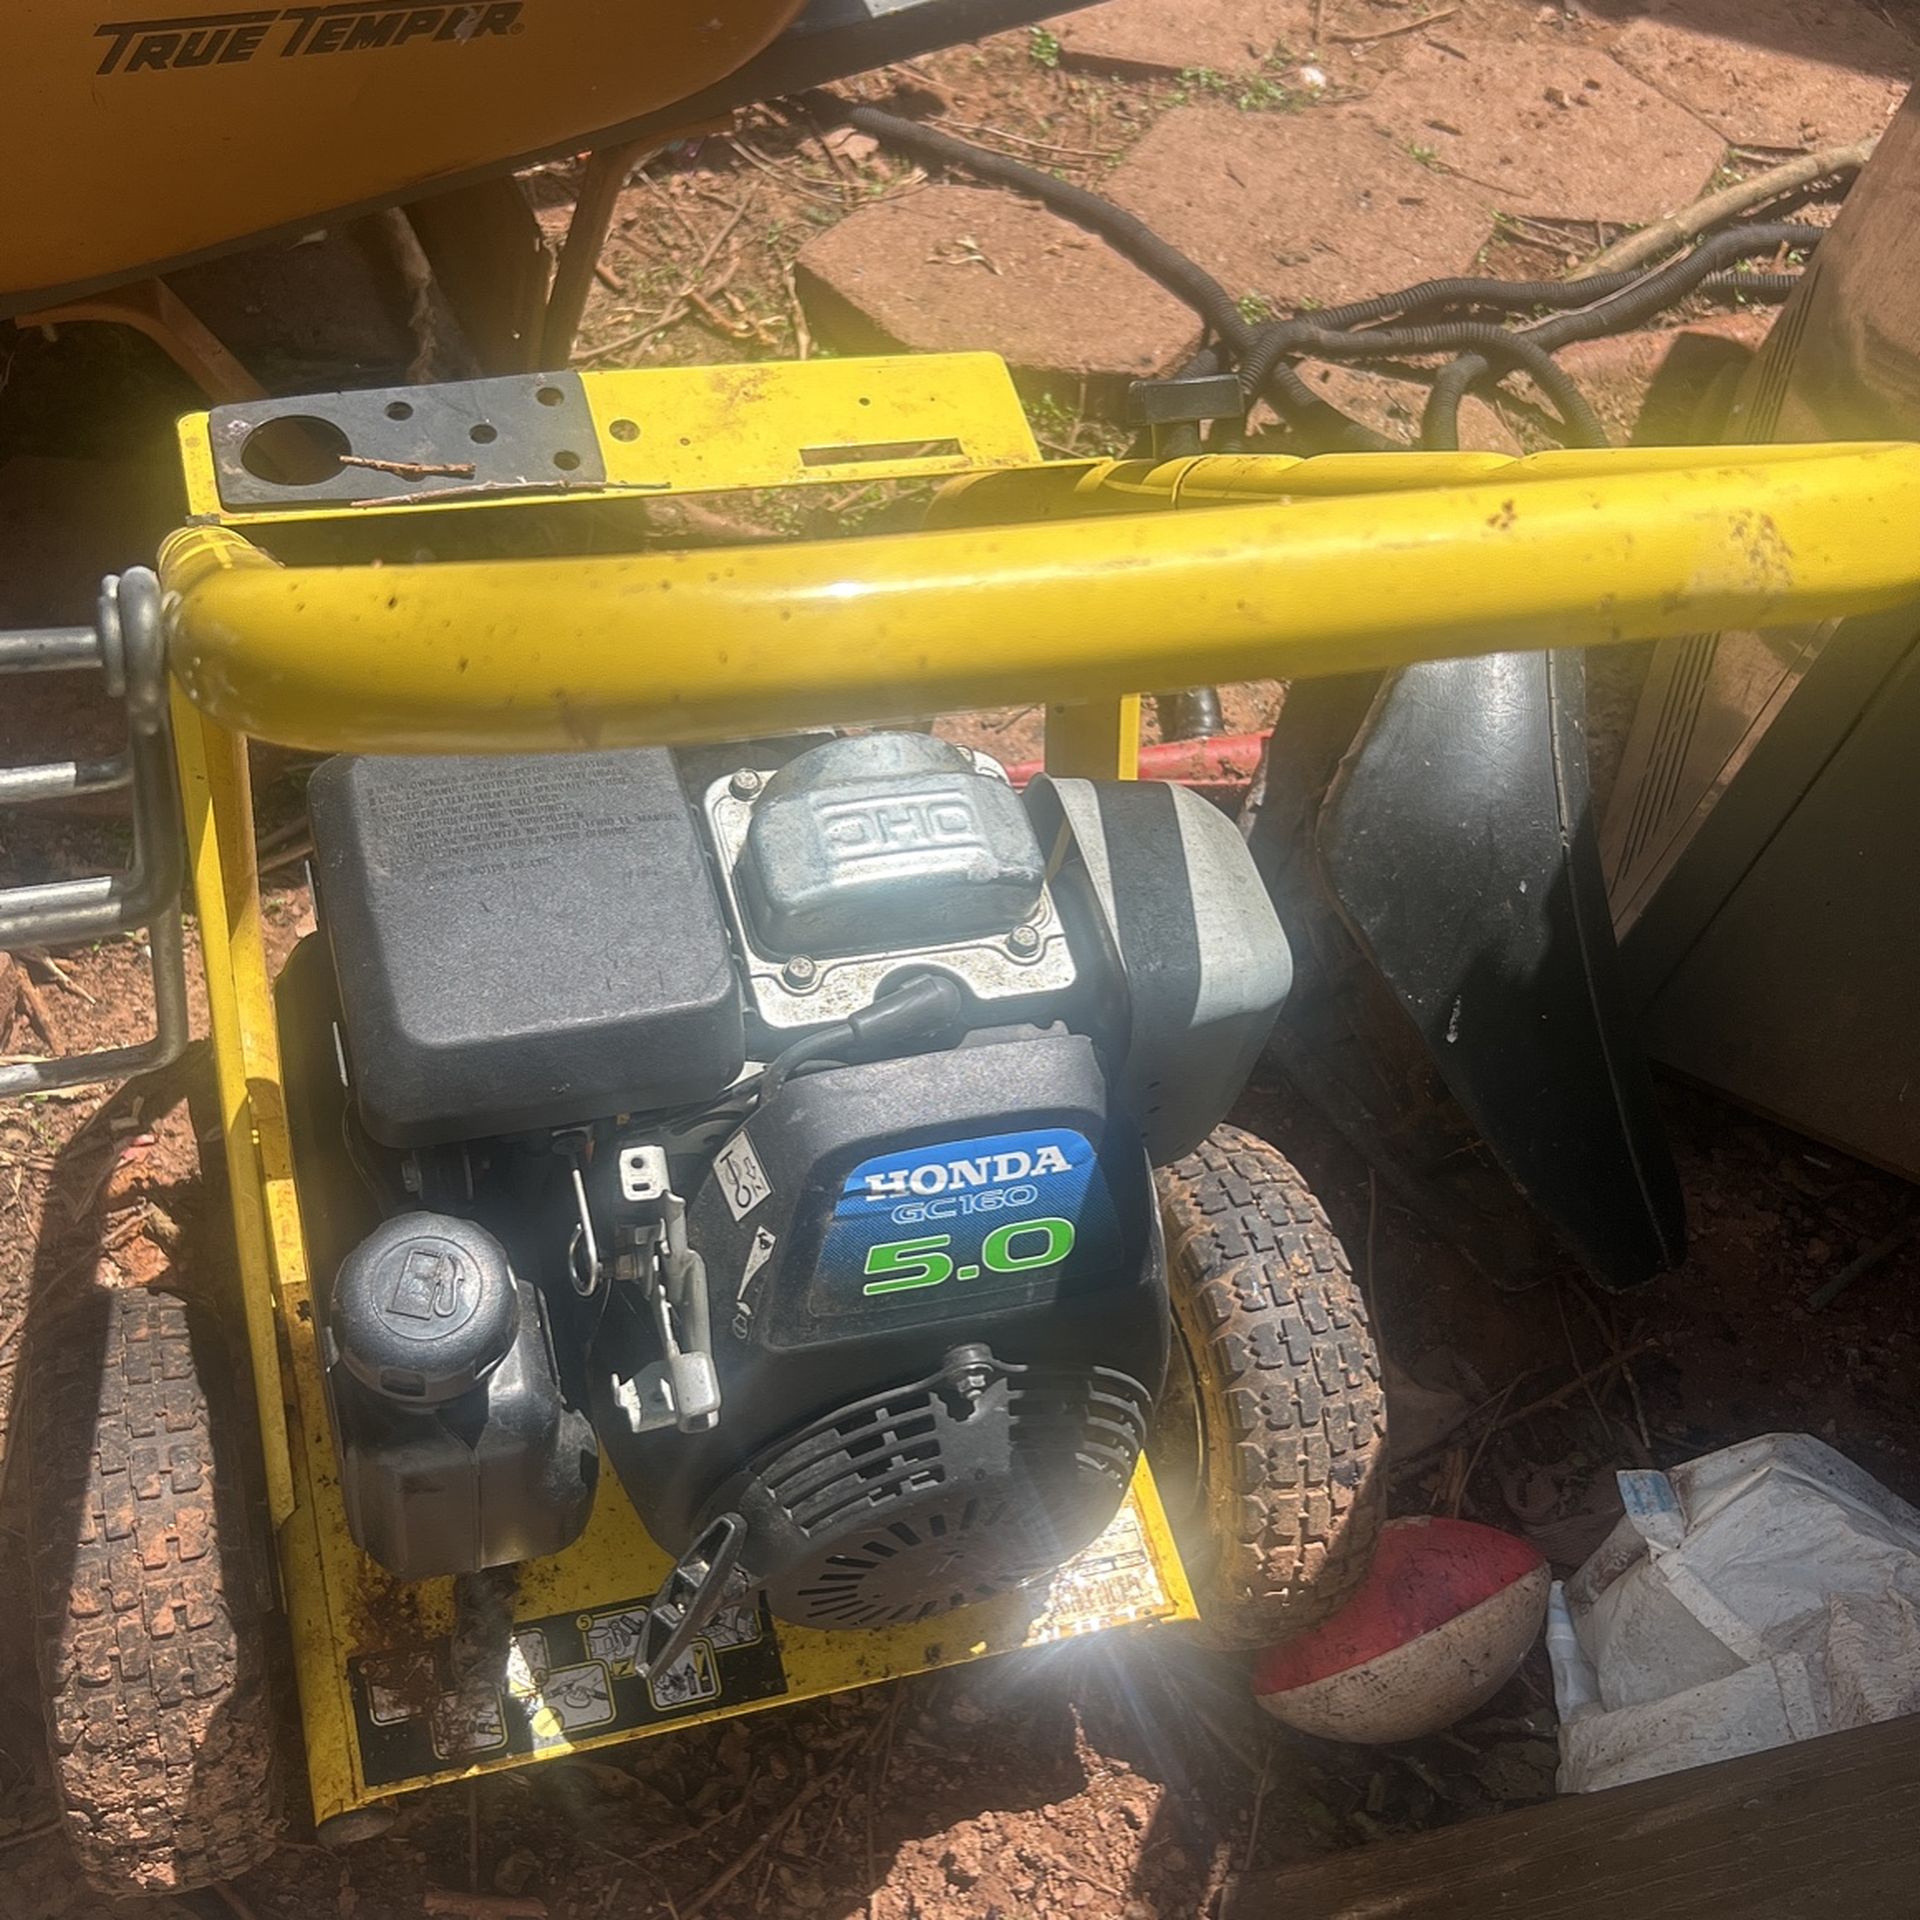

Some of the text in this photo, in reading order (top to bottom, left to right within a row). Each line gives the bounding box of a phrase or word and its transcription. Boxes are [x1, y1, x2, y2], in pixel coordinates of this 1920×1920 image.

[94, 9, 282, 75] TRUE
[865, 1145, 1073, 1201] HONDA
[891, 1184, 1038, 1225] GC160
[863, 1217, 1076, 1296] 5.0
